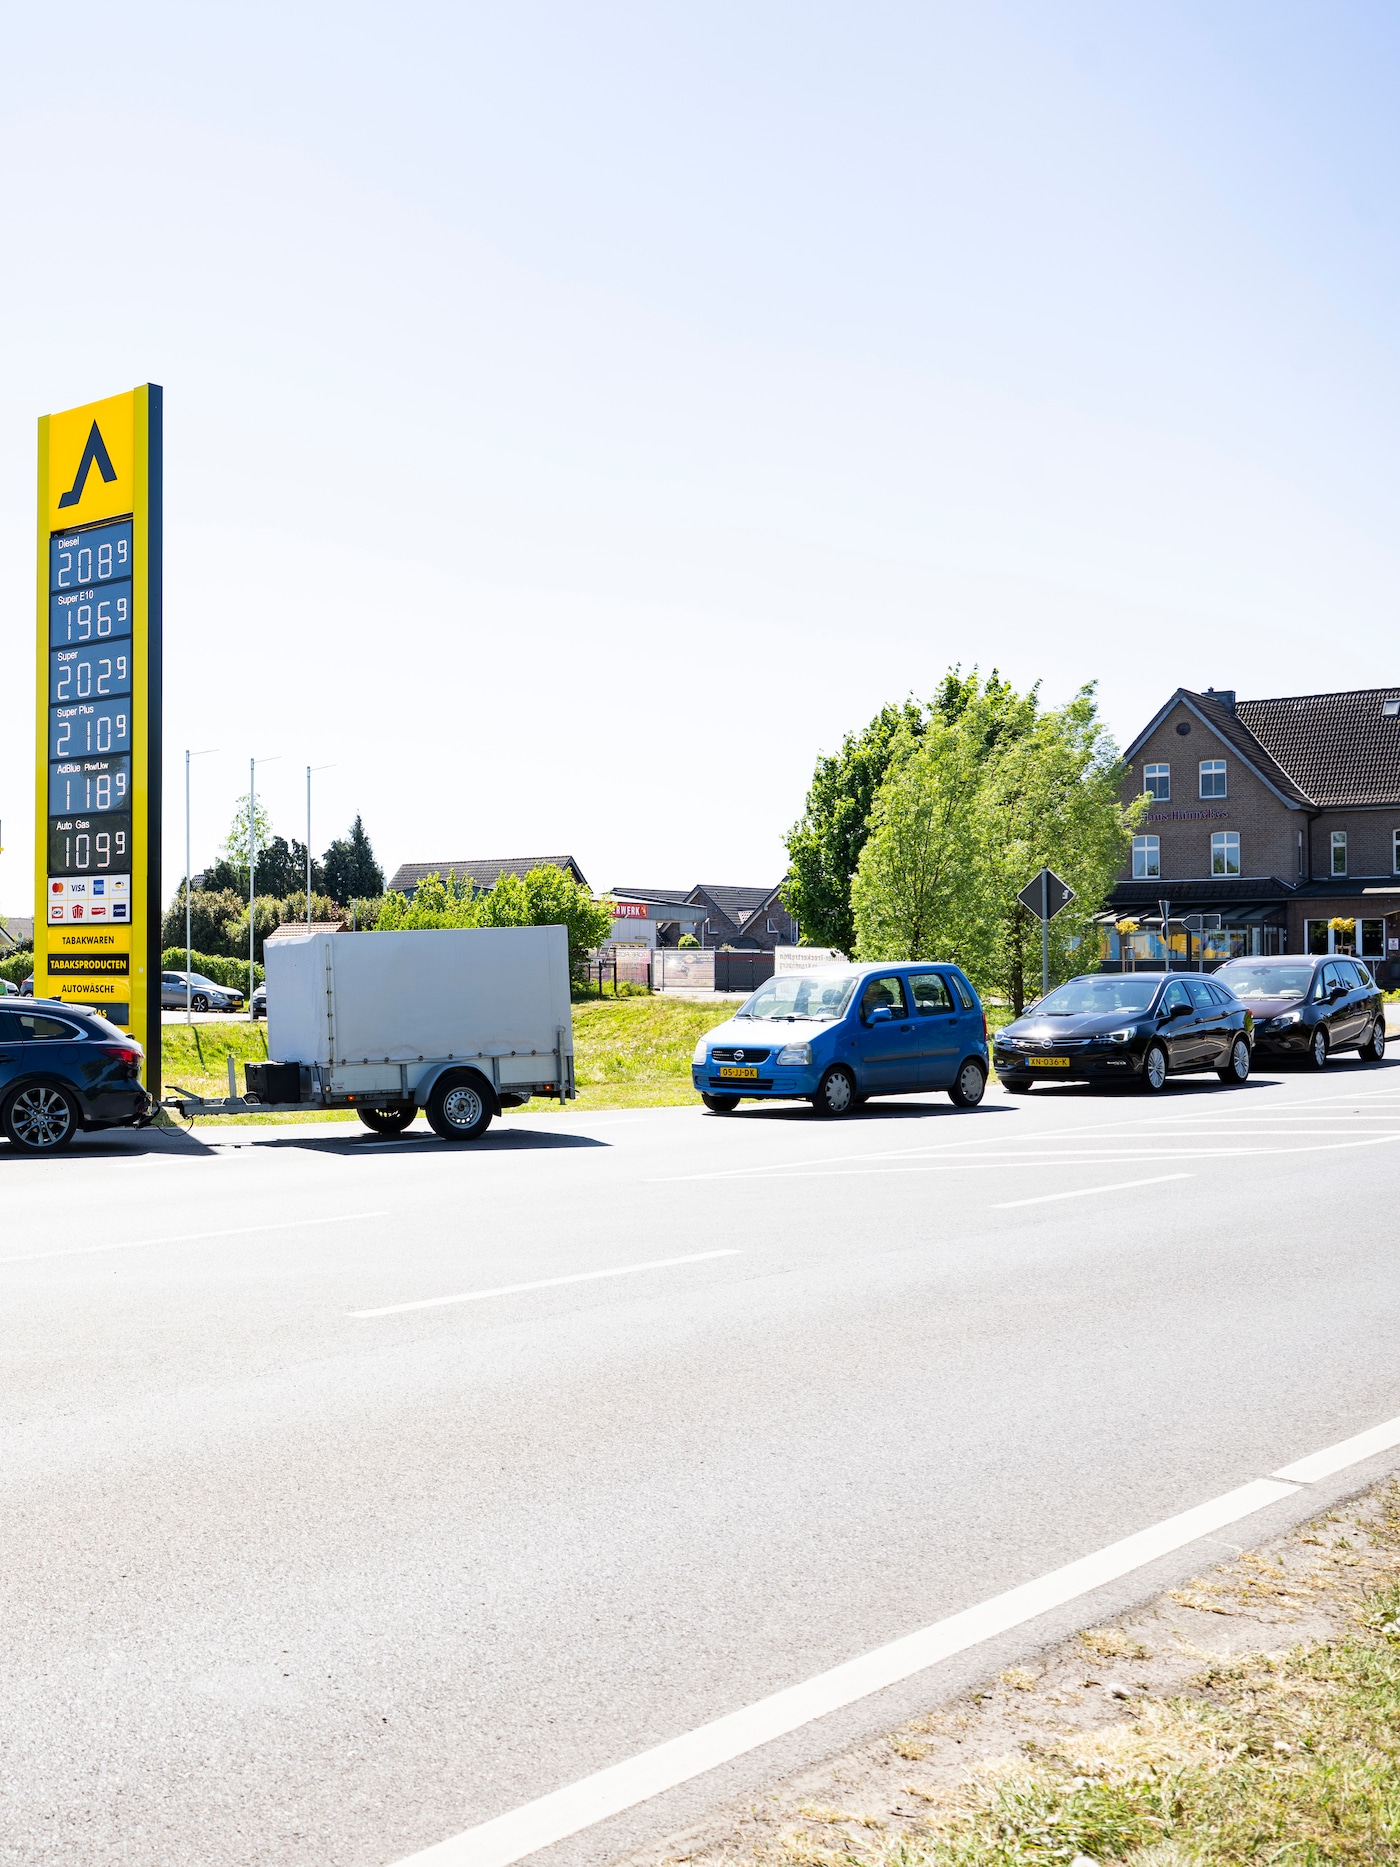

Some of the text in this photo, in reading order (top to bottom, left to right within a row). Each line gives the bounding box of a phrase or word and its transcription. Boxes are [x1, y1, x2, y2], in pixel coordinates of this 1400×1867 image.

[58, 536, 80, 549] Diesel
[57, 589, 94, 605] Super E10
[57, 651, 78, 662] Super
[56, 705, 94, 719] Super Plus
[56, 764, 81, 774] AdBlue
[56, 820, 90, 831] Auto Gas
[71, 884, 86, 892] VISA
[62, 936, 115, 945] TABAKWAREN
[50, 959, 127, 970] TABAKSPRODUCTEN
[61, 982, 115, 993] AUTOWÄSCHE
[722, 1068, 755, 1077] 05-JJ-DK
